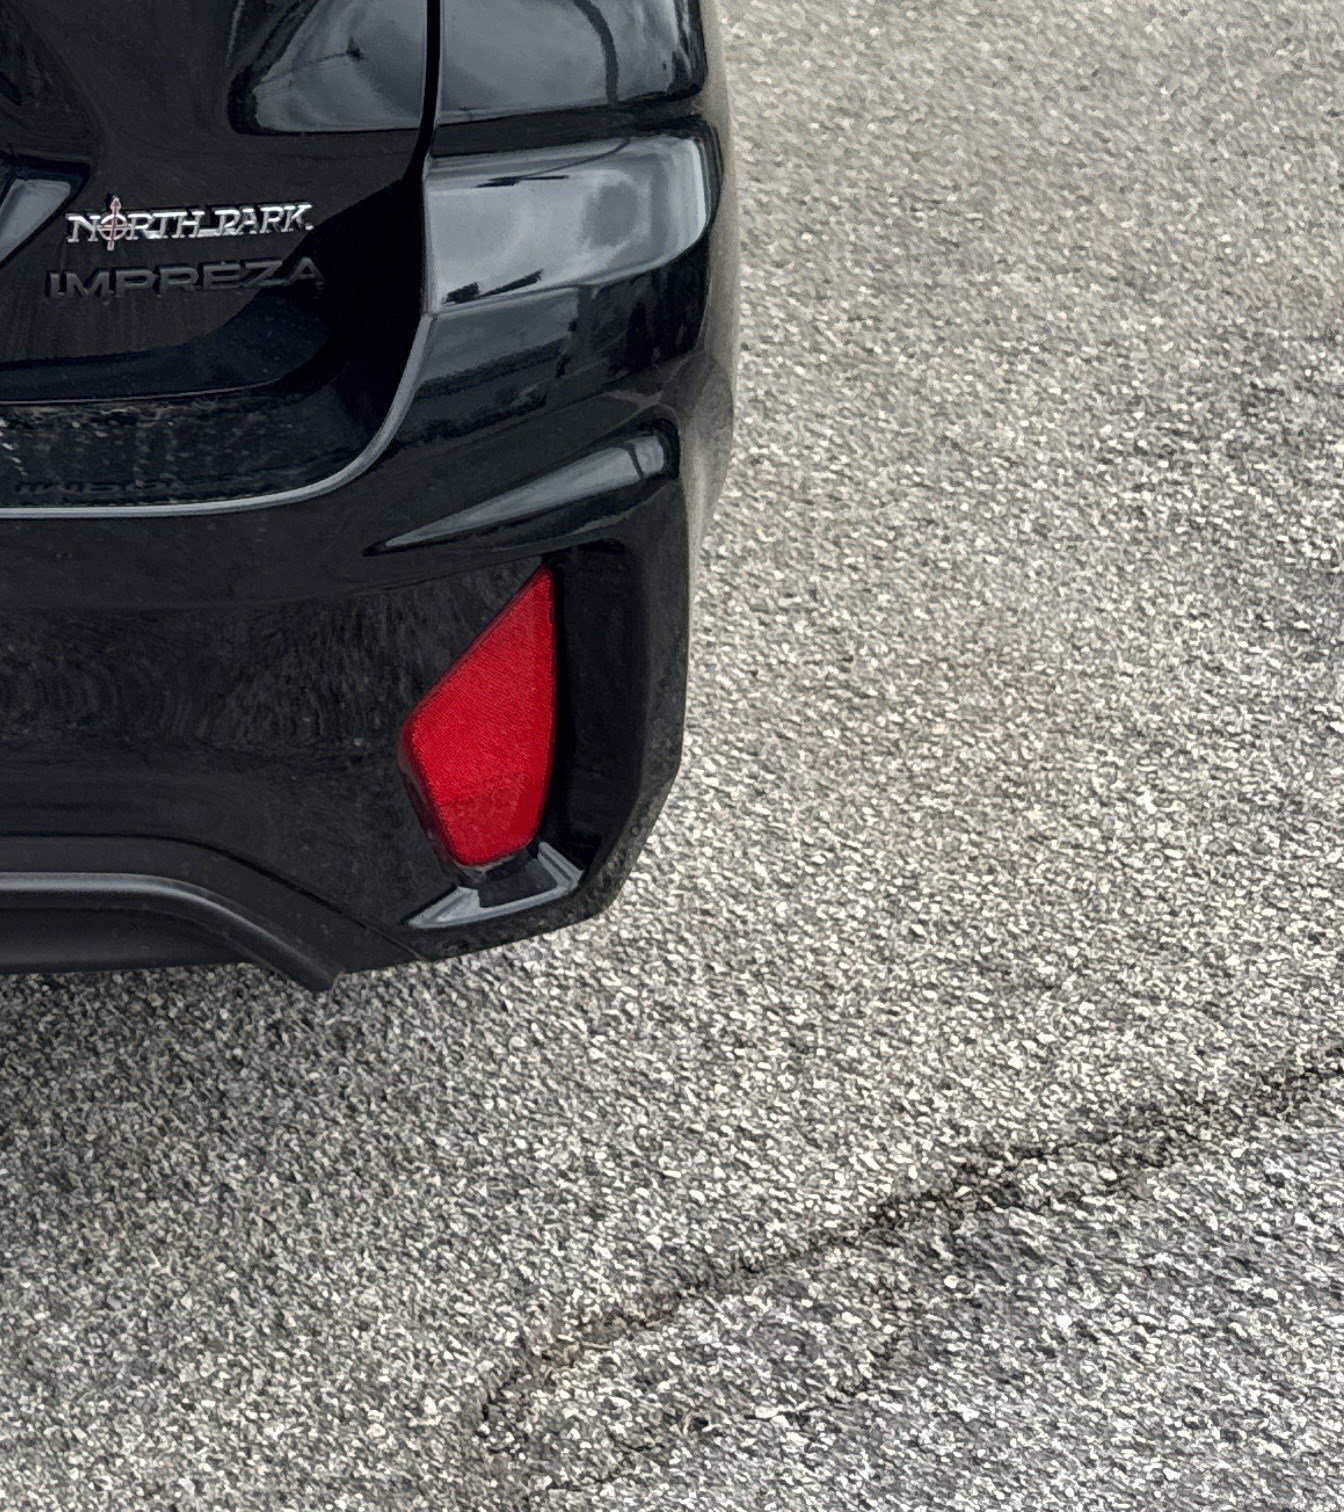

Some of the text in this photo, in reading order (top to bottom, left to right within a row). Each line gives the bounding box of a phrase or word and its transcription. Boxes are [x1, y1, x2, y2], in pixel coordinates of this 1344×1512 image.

[65, 202, 313, 245] NORTH PARK
[48, 256, 325, 299] IMPREZA
